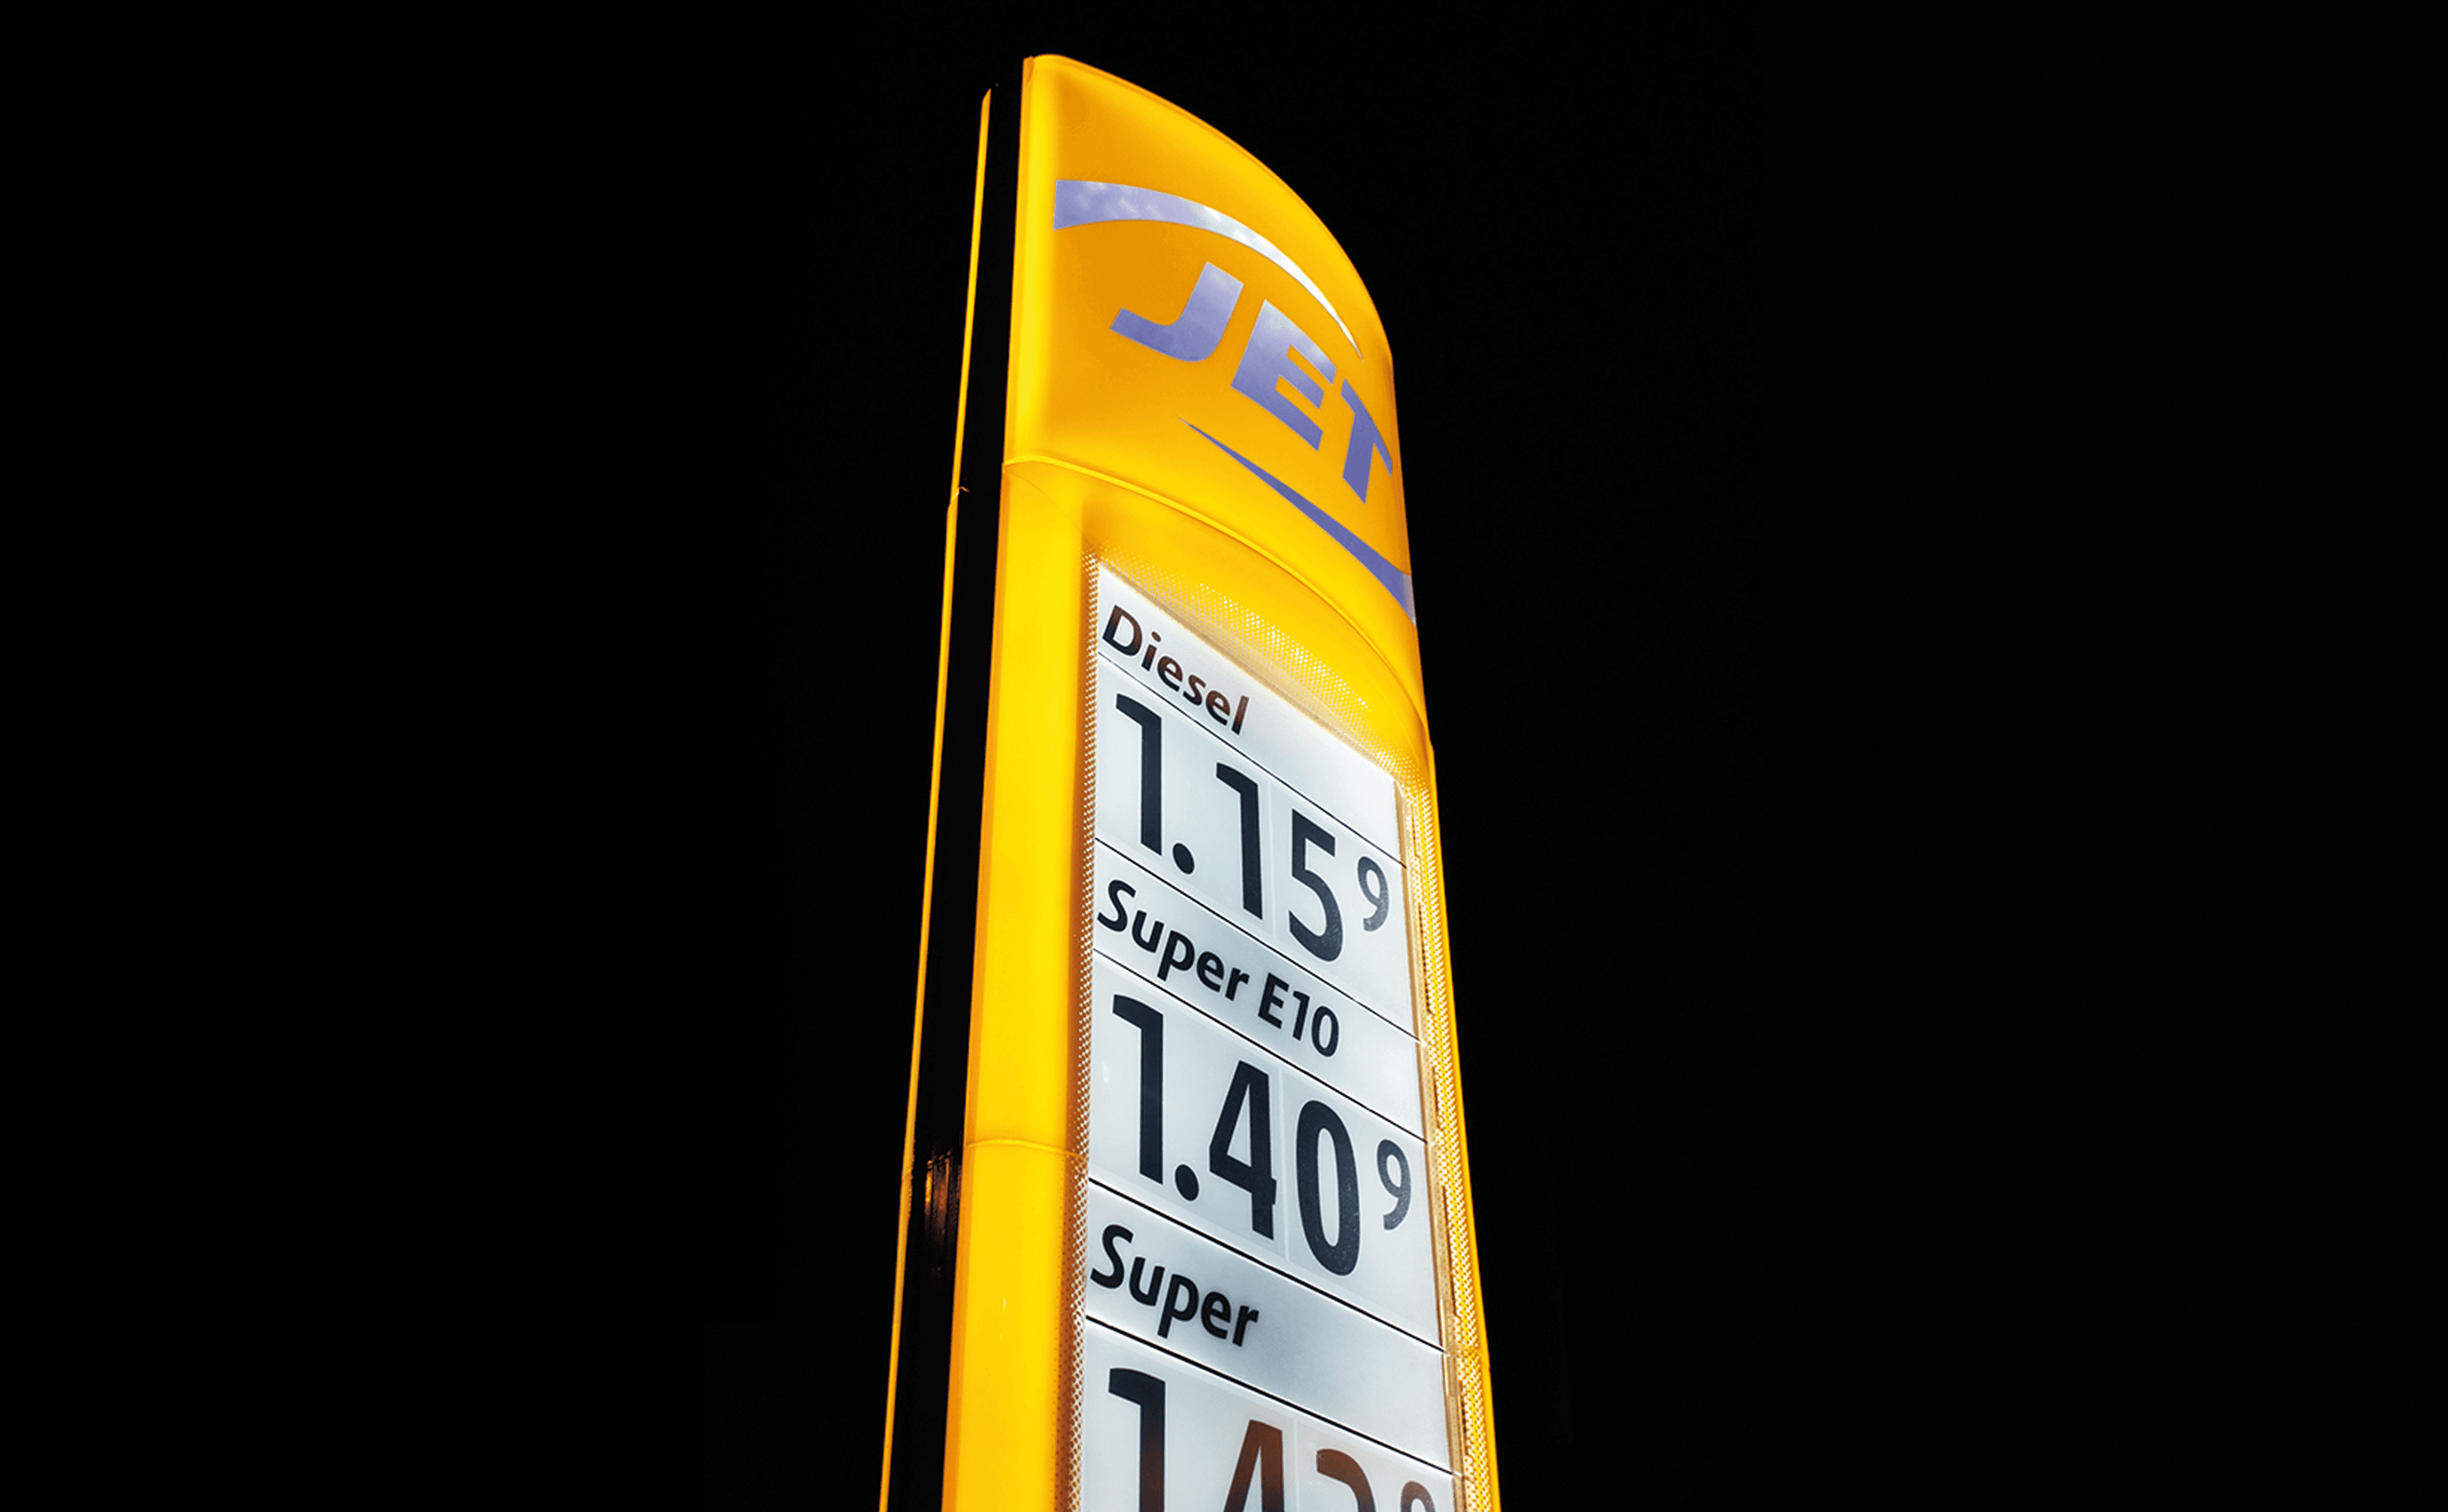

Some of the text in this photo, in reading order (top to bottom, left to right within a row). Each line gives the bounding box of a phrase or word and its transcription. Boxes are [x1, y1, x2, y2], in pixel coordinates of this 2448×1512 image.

[1109, 261, 1393, 504] JET
[1101, 605, 1249, 734] Diesel
[1097, 879, 1339, 1057] Super E10
[1090, 1224, 1259, 1347] Super
